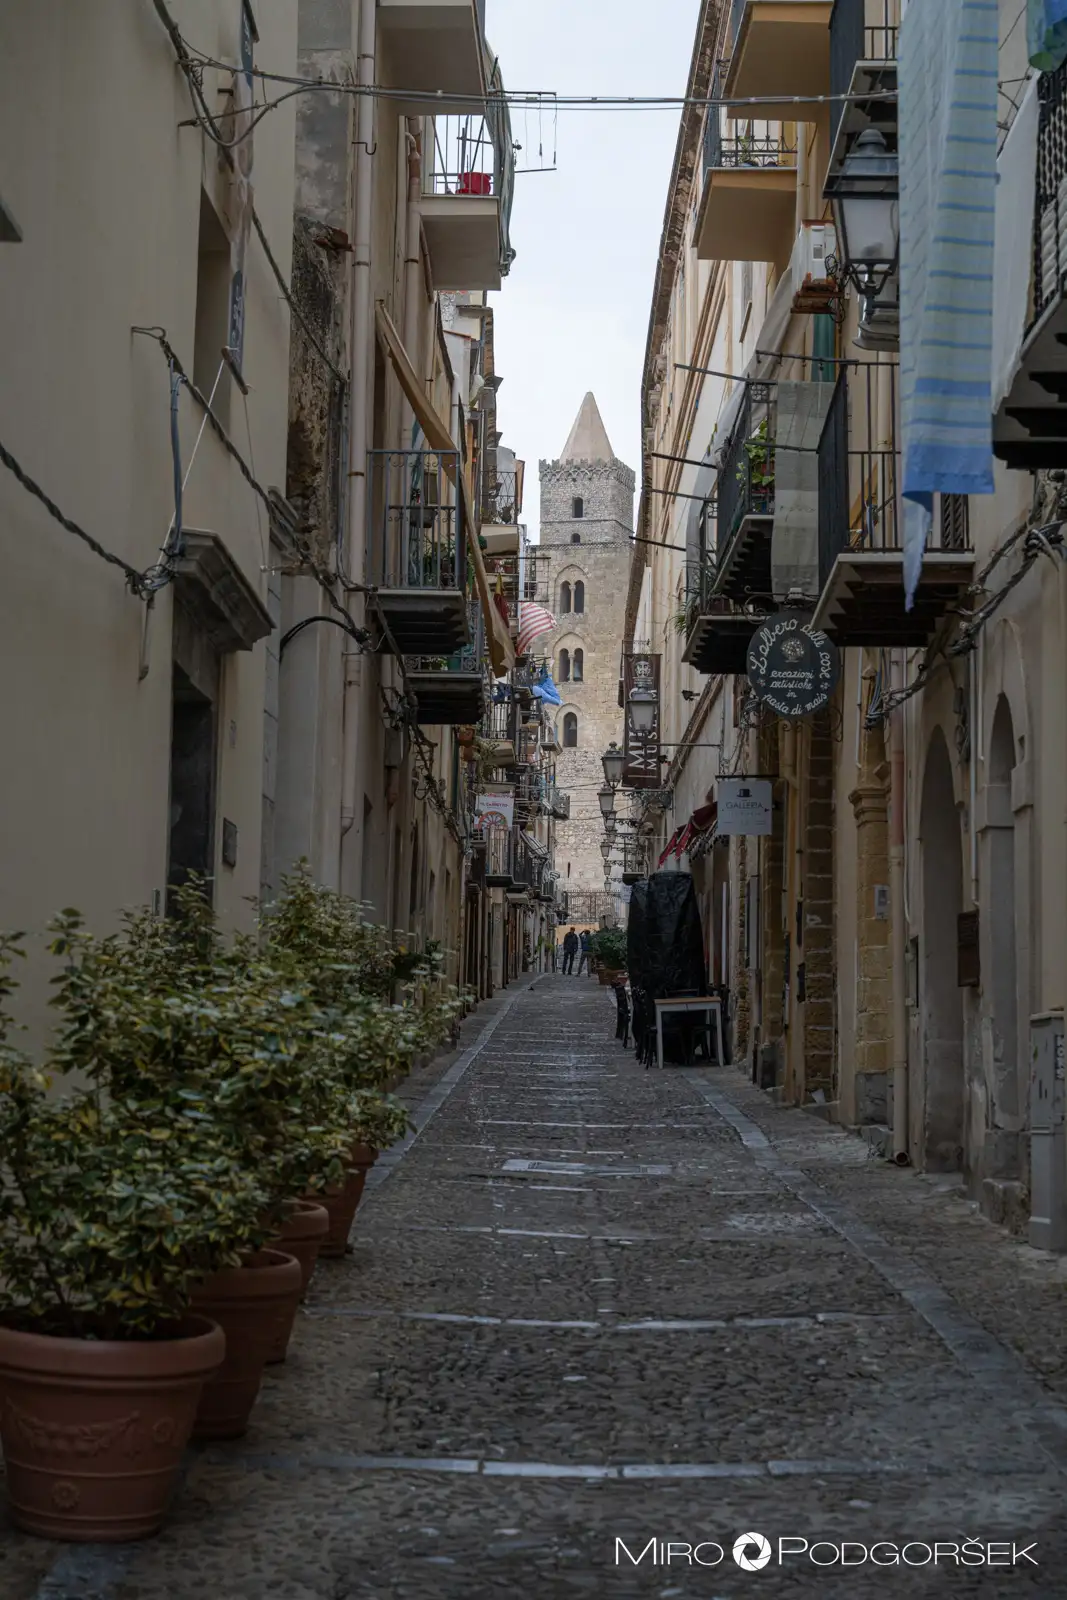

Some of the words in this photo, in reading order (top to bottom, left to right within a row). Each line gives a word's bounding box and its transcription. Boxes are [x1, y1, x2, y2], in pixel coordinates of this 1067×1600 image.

[749, 618, 799, 675] L'albero
[818, 651, 832, 679] cose
[770, 669, 814, 680] creazioni
[770, 679, 813, 690] artistiche
[786, 689, 798, 698] in
[761, 694, 790, 714] pasta
[790, 703, 803, 715] di
[805, 693, 828, 712] mais
[725, 801, 764, 809] GALLERIA
